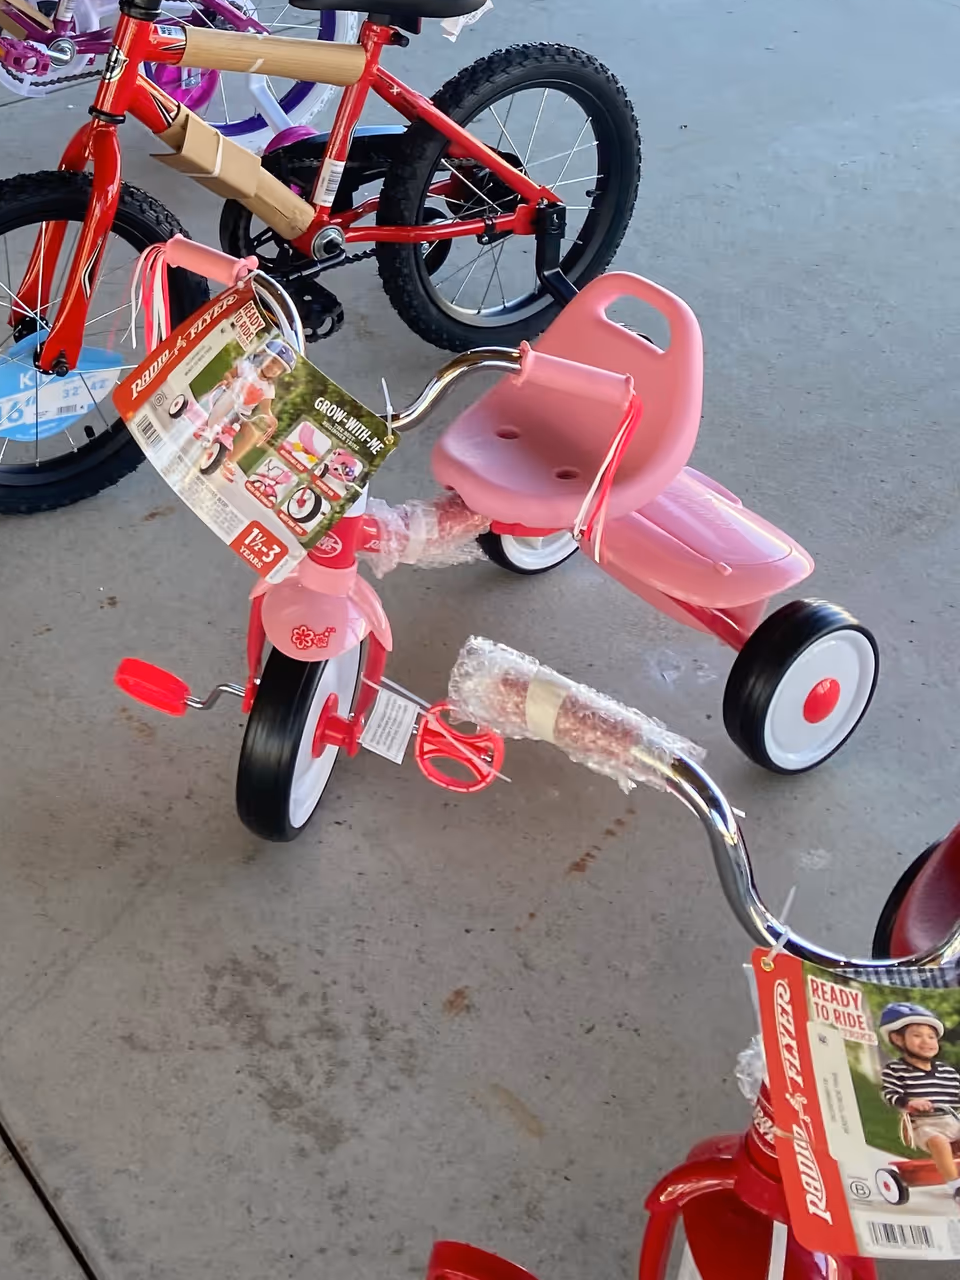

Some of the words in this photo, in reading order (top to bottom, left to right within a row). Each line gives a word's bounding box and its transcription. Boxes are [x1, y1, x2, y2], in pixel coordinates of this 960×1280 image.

[233, 310, 245, 324] TO
[239, 320, 255, 341] RIDE
[242, 303, 265, 331] READY
[130, 349, 171, 401] RADIO
[188, 294, 239, 341] FLYER
[314, 397, 385, 455] GROW-WITH-ME
[239, 545, 264, 569] YEARS
[810, 977, 859, 1011] READY
[813, 1001, 830, 1021] TO
[833, 1008, 866, 1031] RIDE
[774, 979, 805, 1089] FLYER
[792, 1123, 833, 1226] RADIO
